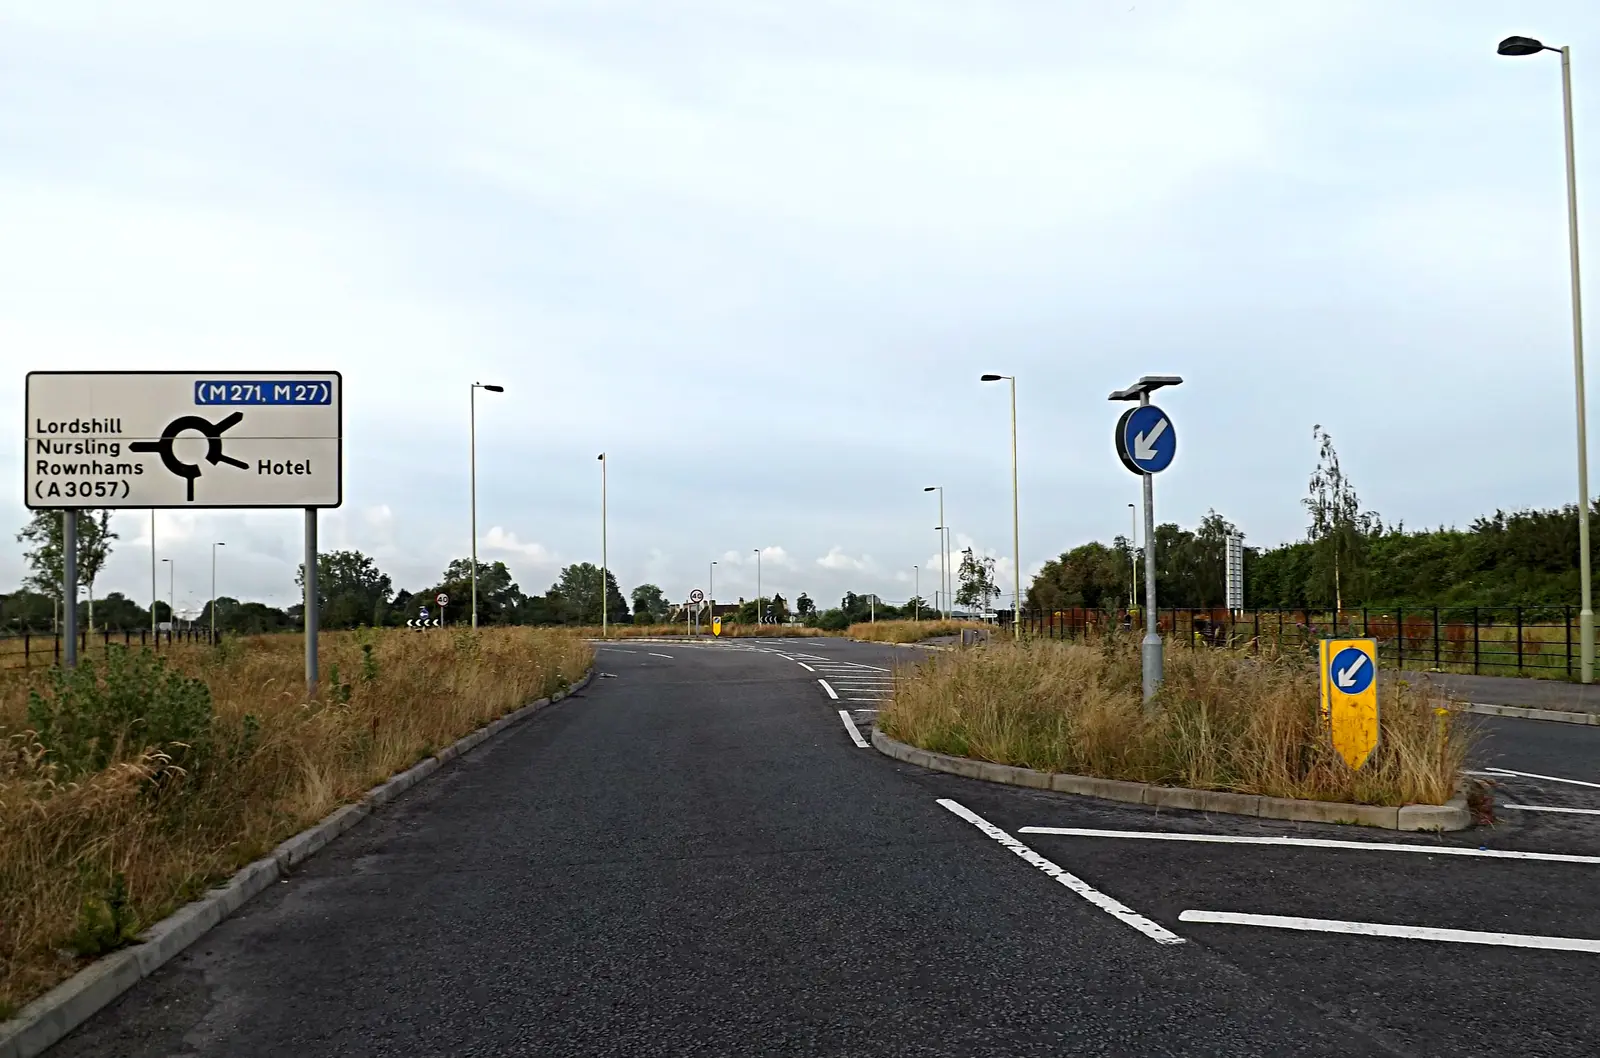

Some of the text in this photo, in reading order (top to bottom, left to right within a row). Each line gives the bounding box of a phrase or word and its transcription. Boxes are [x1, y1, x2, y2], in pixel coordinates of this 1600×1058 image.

[36, 418, 122, 434] Lordshill
[36, 440, 121, 458] Nursling
[36, 459, 144, 476] Rownhams
[258, 459, 312, 476] Hotel
[692, 592, 703, 600] 40
